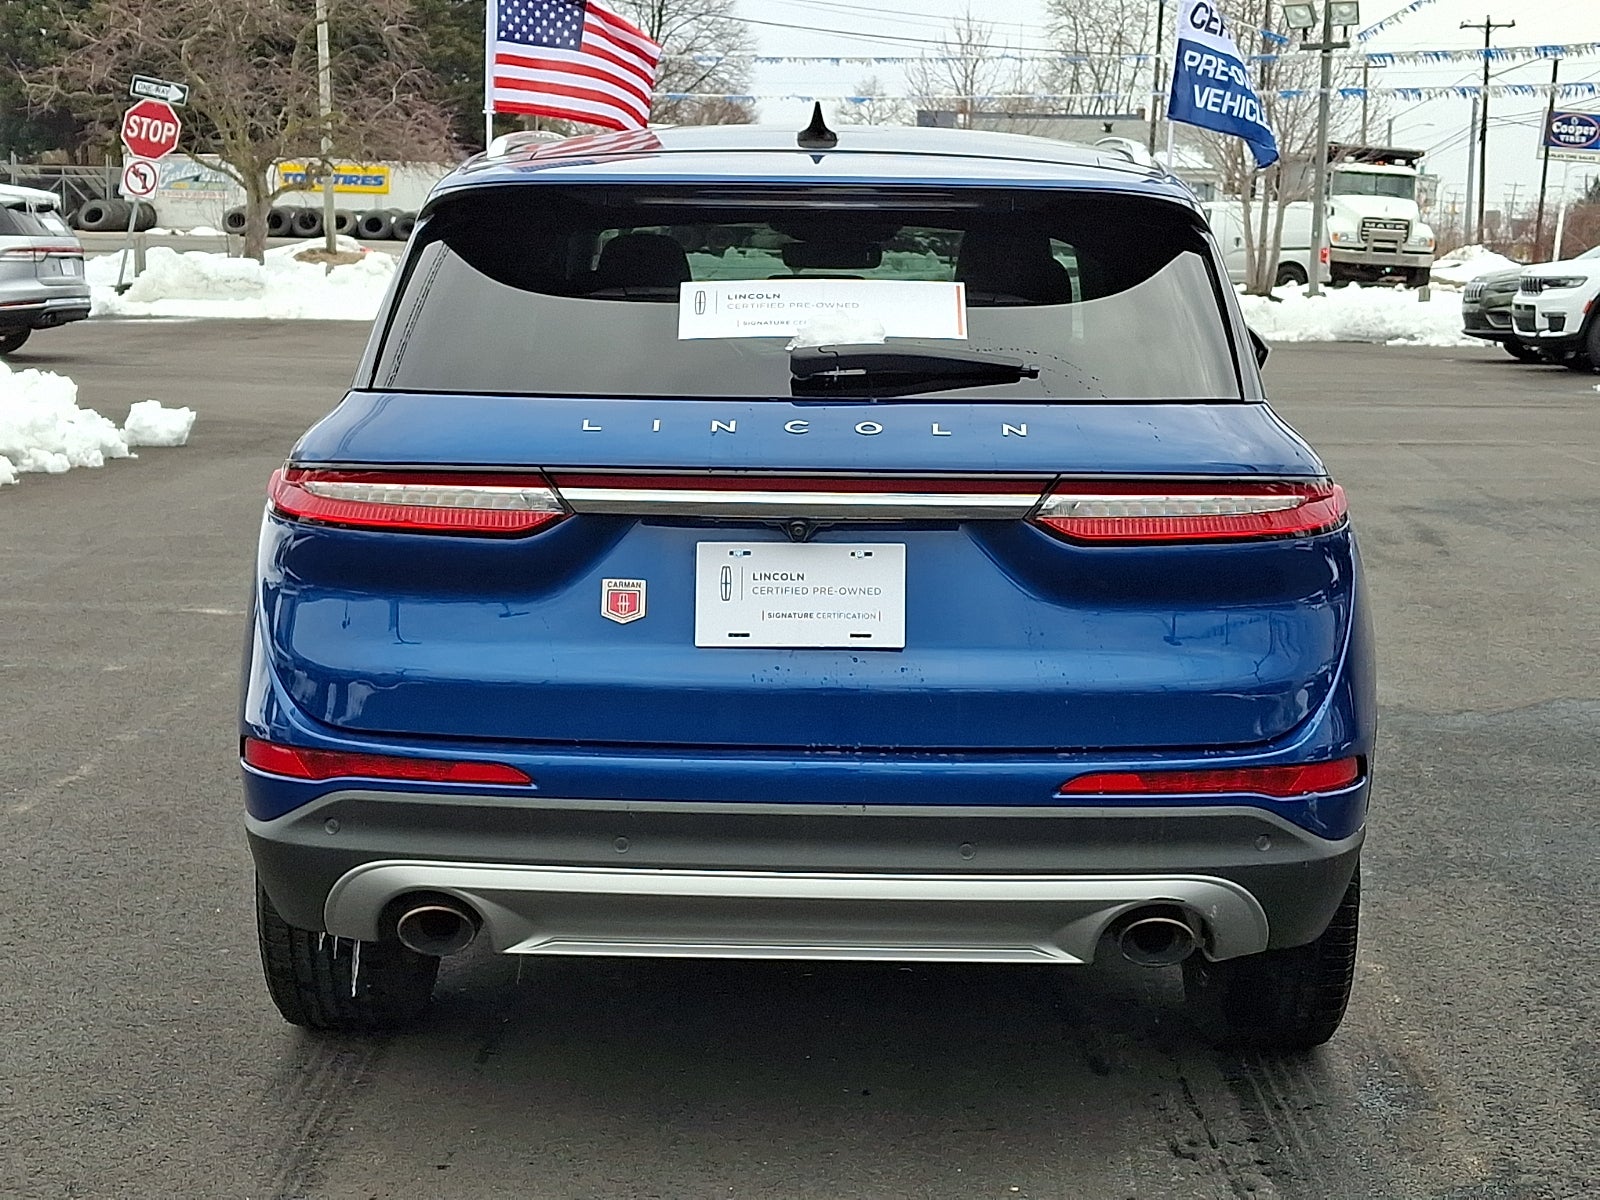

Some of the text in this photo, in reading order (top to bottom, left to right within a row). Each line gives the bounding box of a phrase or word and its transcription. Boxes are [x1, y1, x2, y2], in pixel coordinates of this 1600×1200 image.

[137, 82, 170, 96] ONE WAY
[126, 115, 176, 144] STOP
[1551, 121, 1597, 136] Cooper
[726, 302, 785, 310] CERTIFIED
[582, 418, 1027, 437] LINCOLN
[752, 572, 805, 581] LINCOLN
[607, 580, 642, 588] CARMAN
[752, 586, 882, 596] CERTIFIED PRE-OWNED
[816, 612, 876, 620] CERTIFICATION
